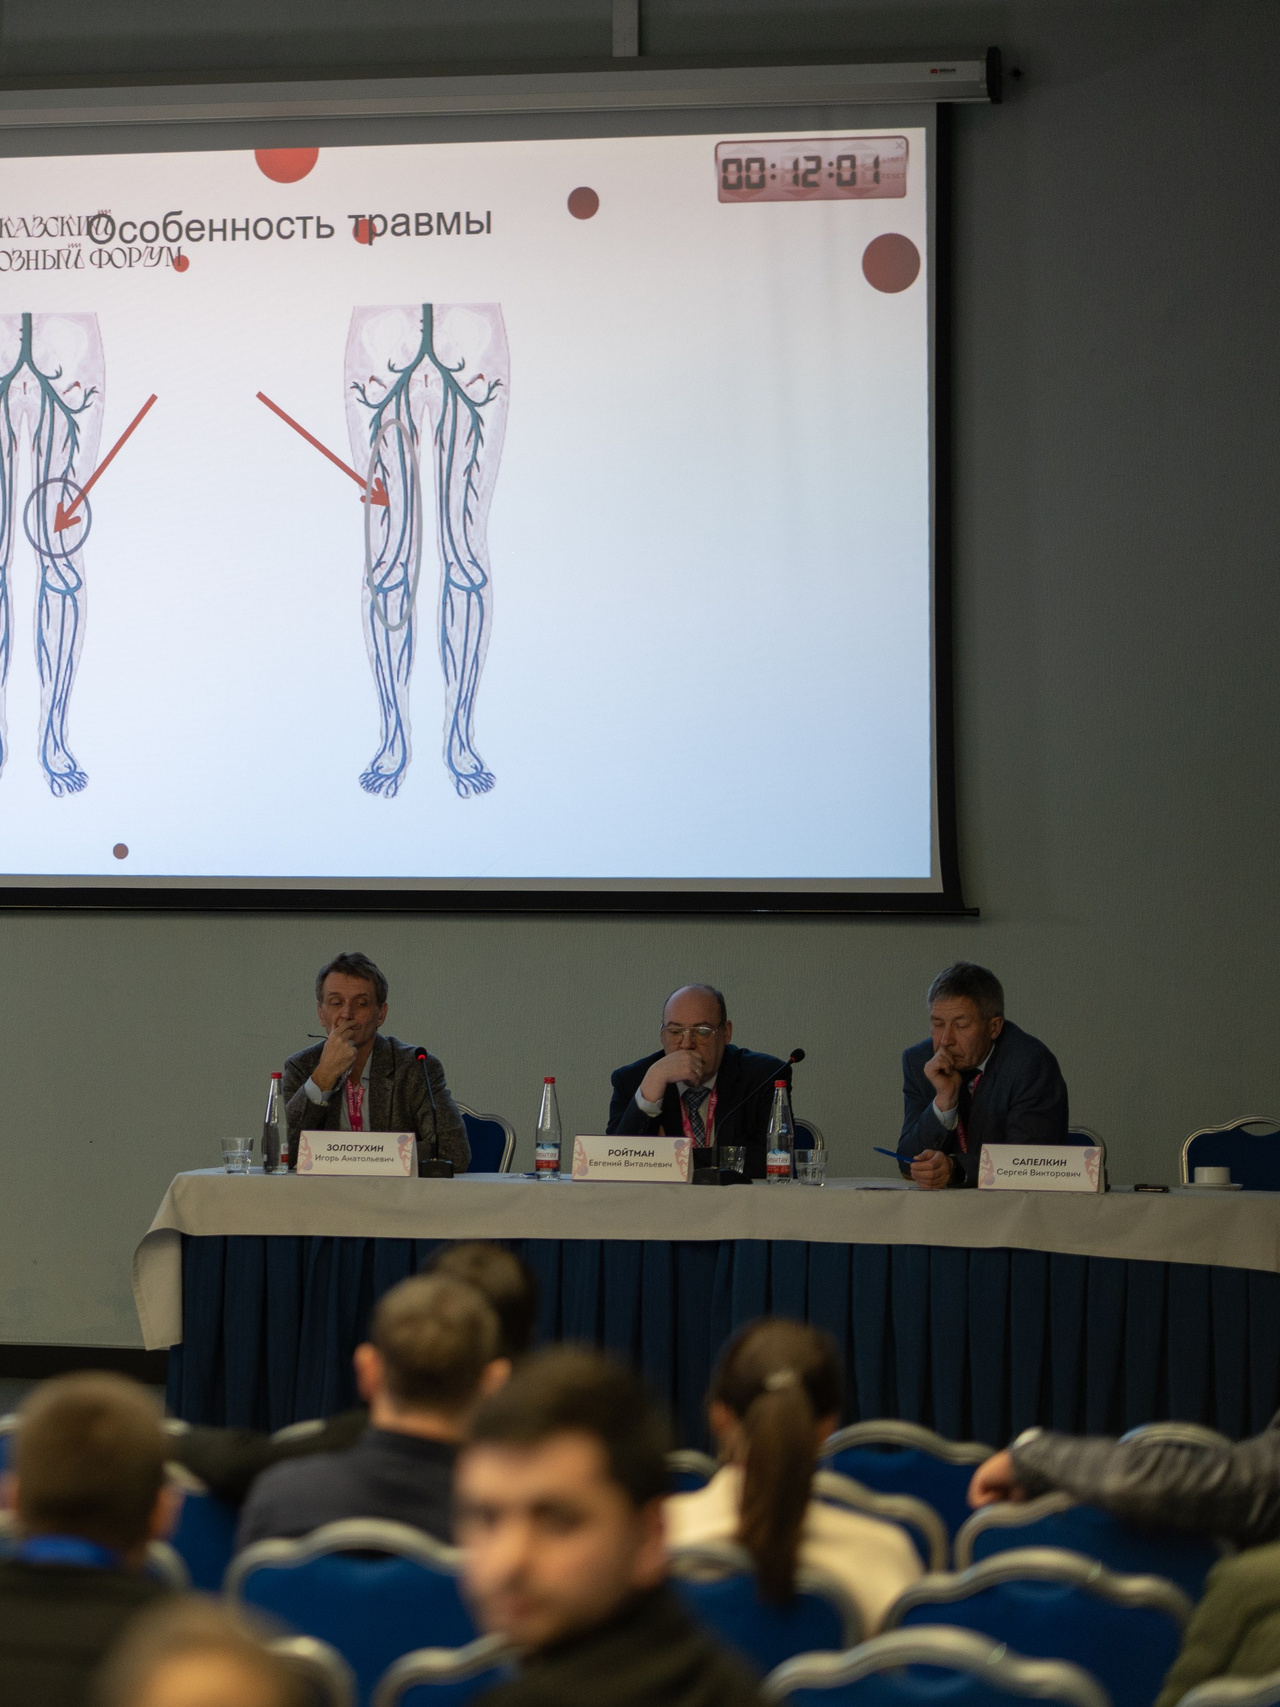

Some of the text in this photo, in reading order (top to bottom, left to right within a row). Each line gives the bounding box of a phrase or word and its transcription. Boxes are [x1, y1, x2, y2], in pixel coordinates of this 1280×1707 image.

[722, 154, 880, 191] 00:12:01
[88, 210, 492, 246] Особенность травмы
[89, 245, 183, 269] ФОРУМ
[326, 1144, 384, 1152] ЗОЛОТУХИН
[608, 1147, 655, 1157] РОЙТМАН
[315, 1154, 394, 1163] Игорь Анатольевич
[588, 1158, 622, 1167] Евгений
[1012, 1158, 1067, 1167] САПЕЛКИН
[996, 1168, 1081, 1178] Сергей Викторович
